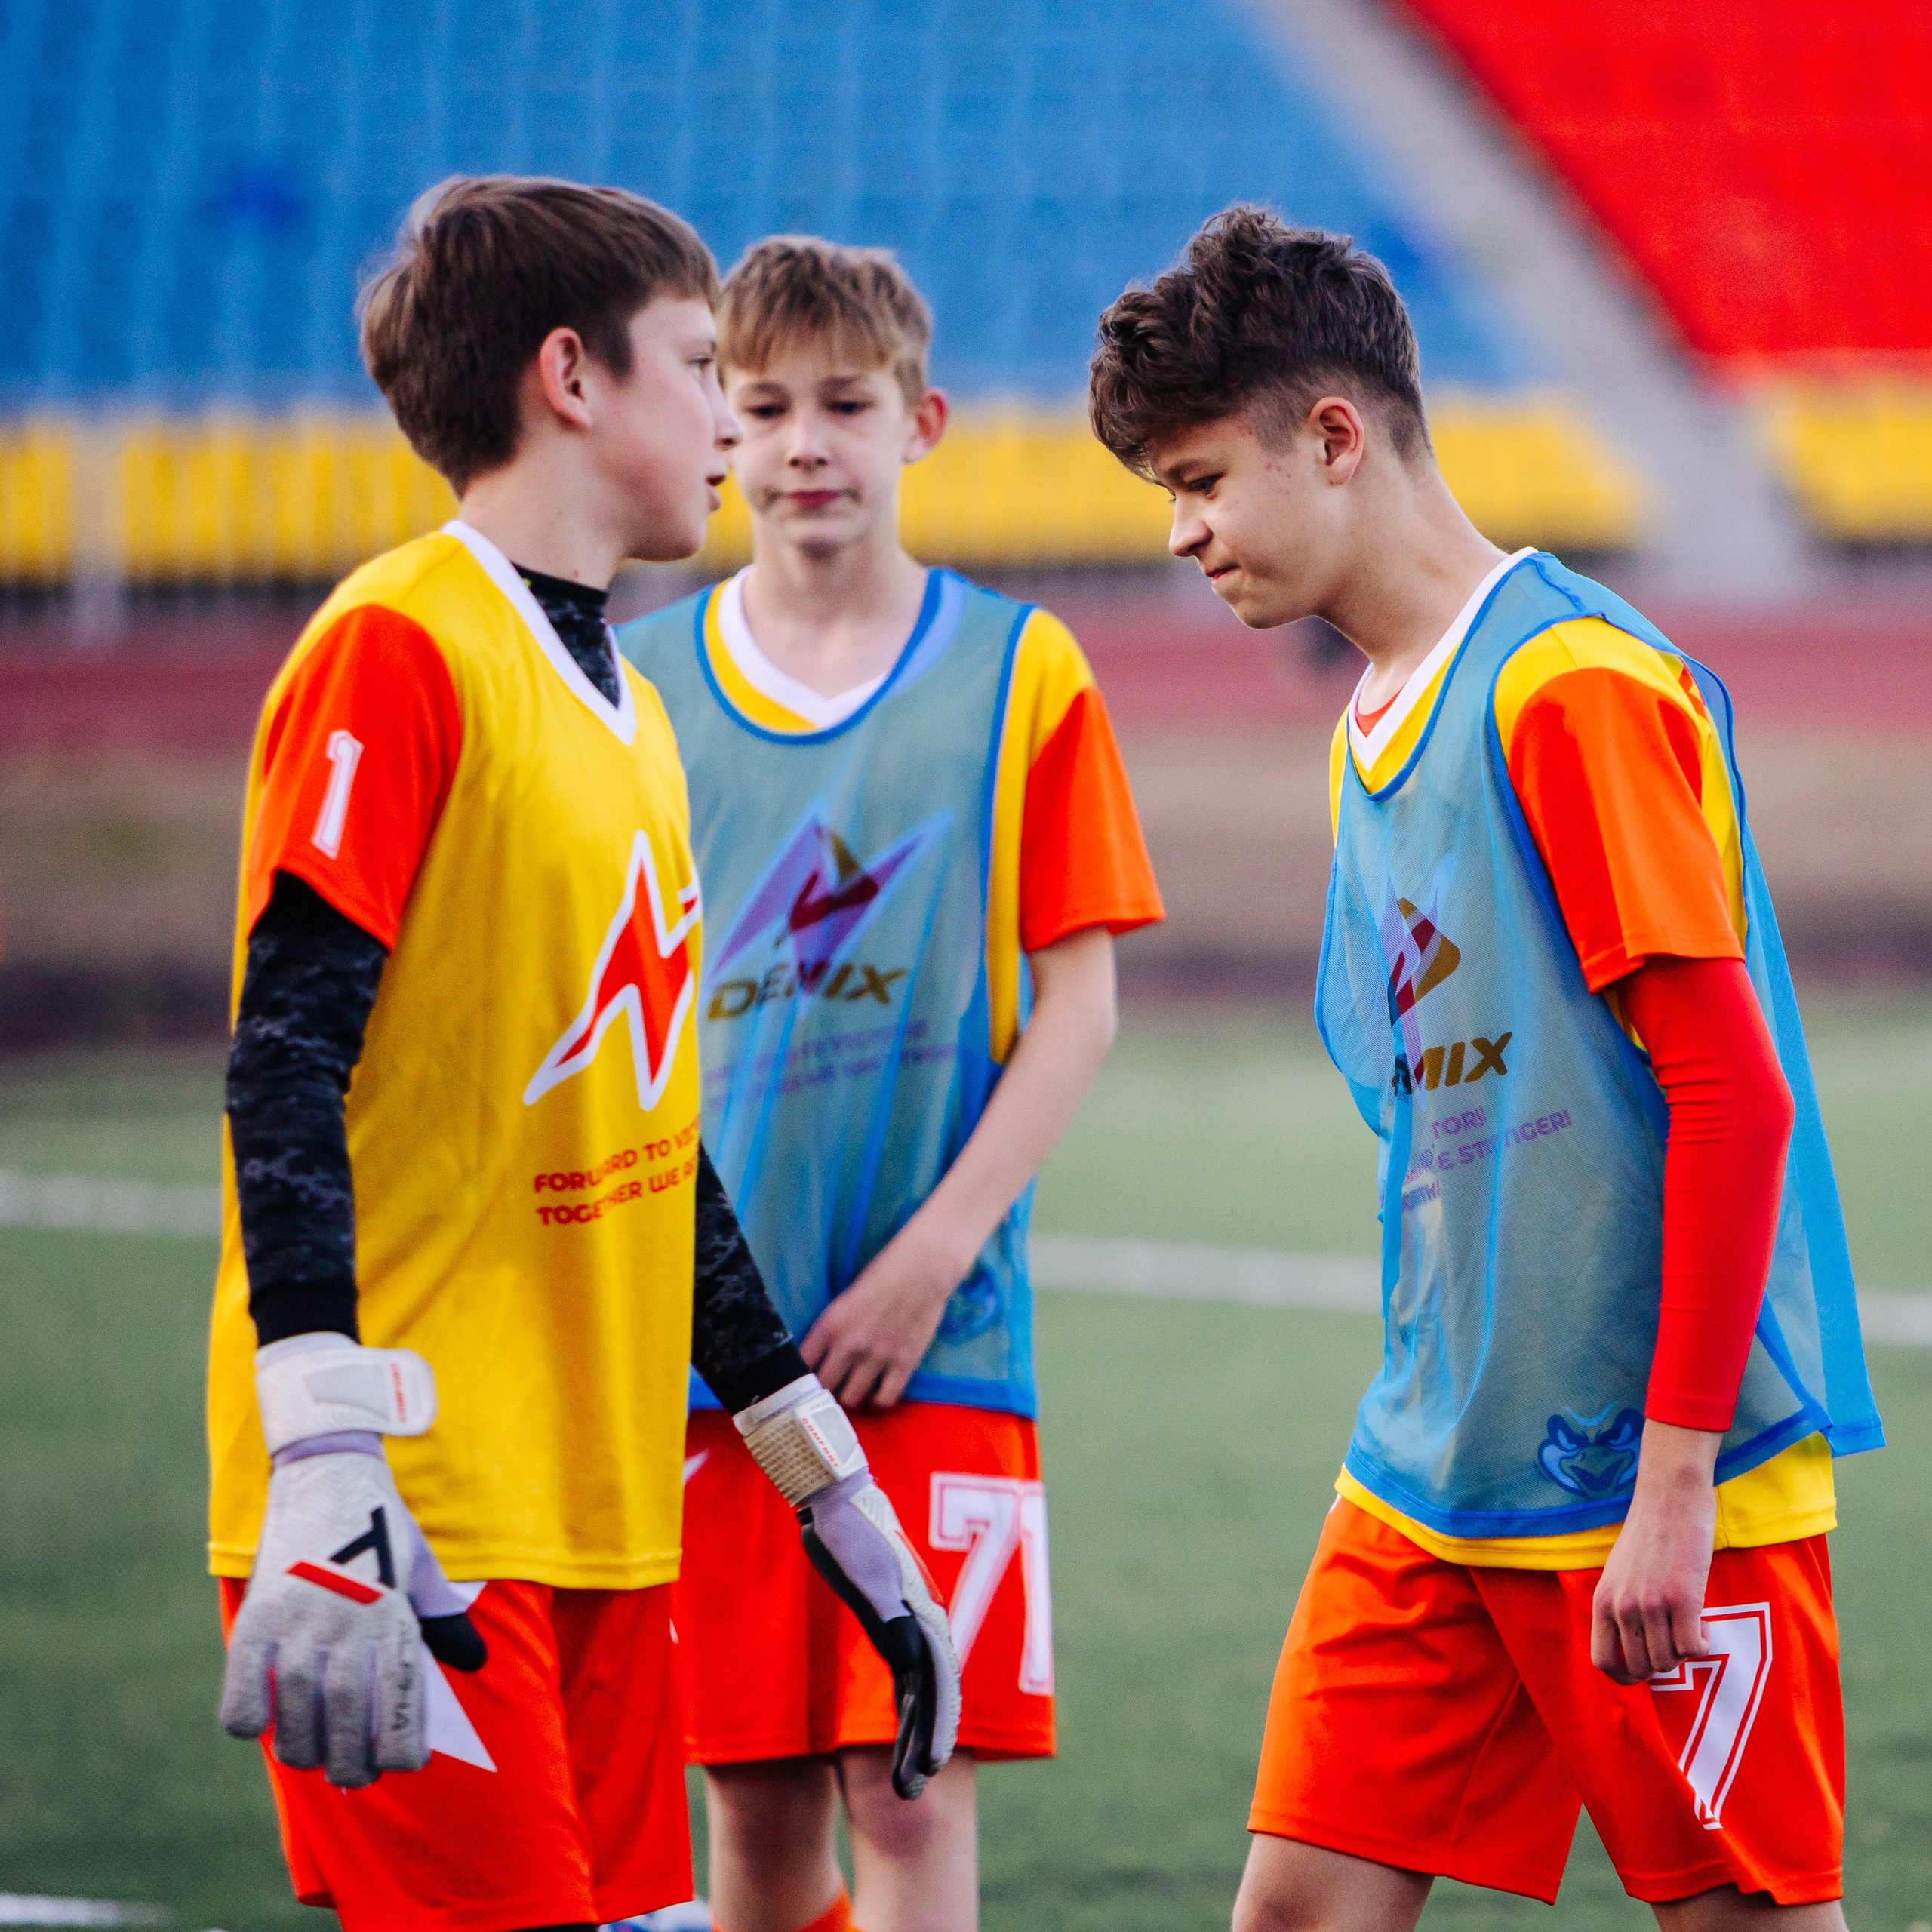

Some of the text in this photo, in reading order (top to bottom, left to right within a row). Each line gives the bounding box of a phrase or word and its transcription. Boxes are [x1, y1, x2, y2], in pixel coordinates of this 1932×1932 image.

[310, 729, 364, 860] 1
[644, 1138, 672, 1162] TO
[1648, 1601, 1774, 1831] 7
